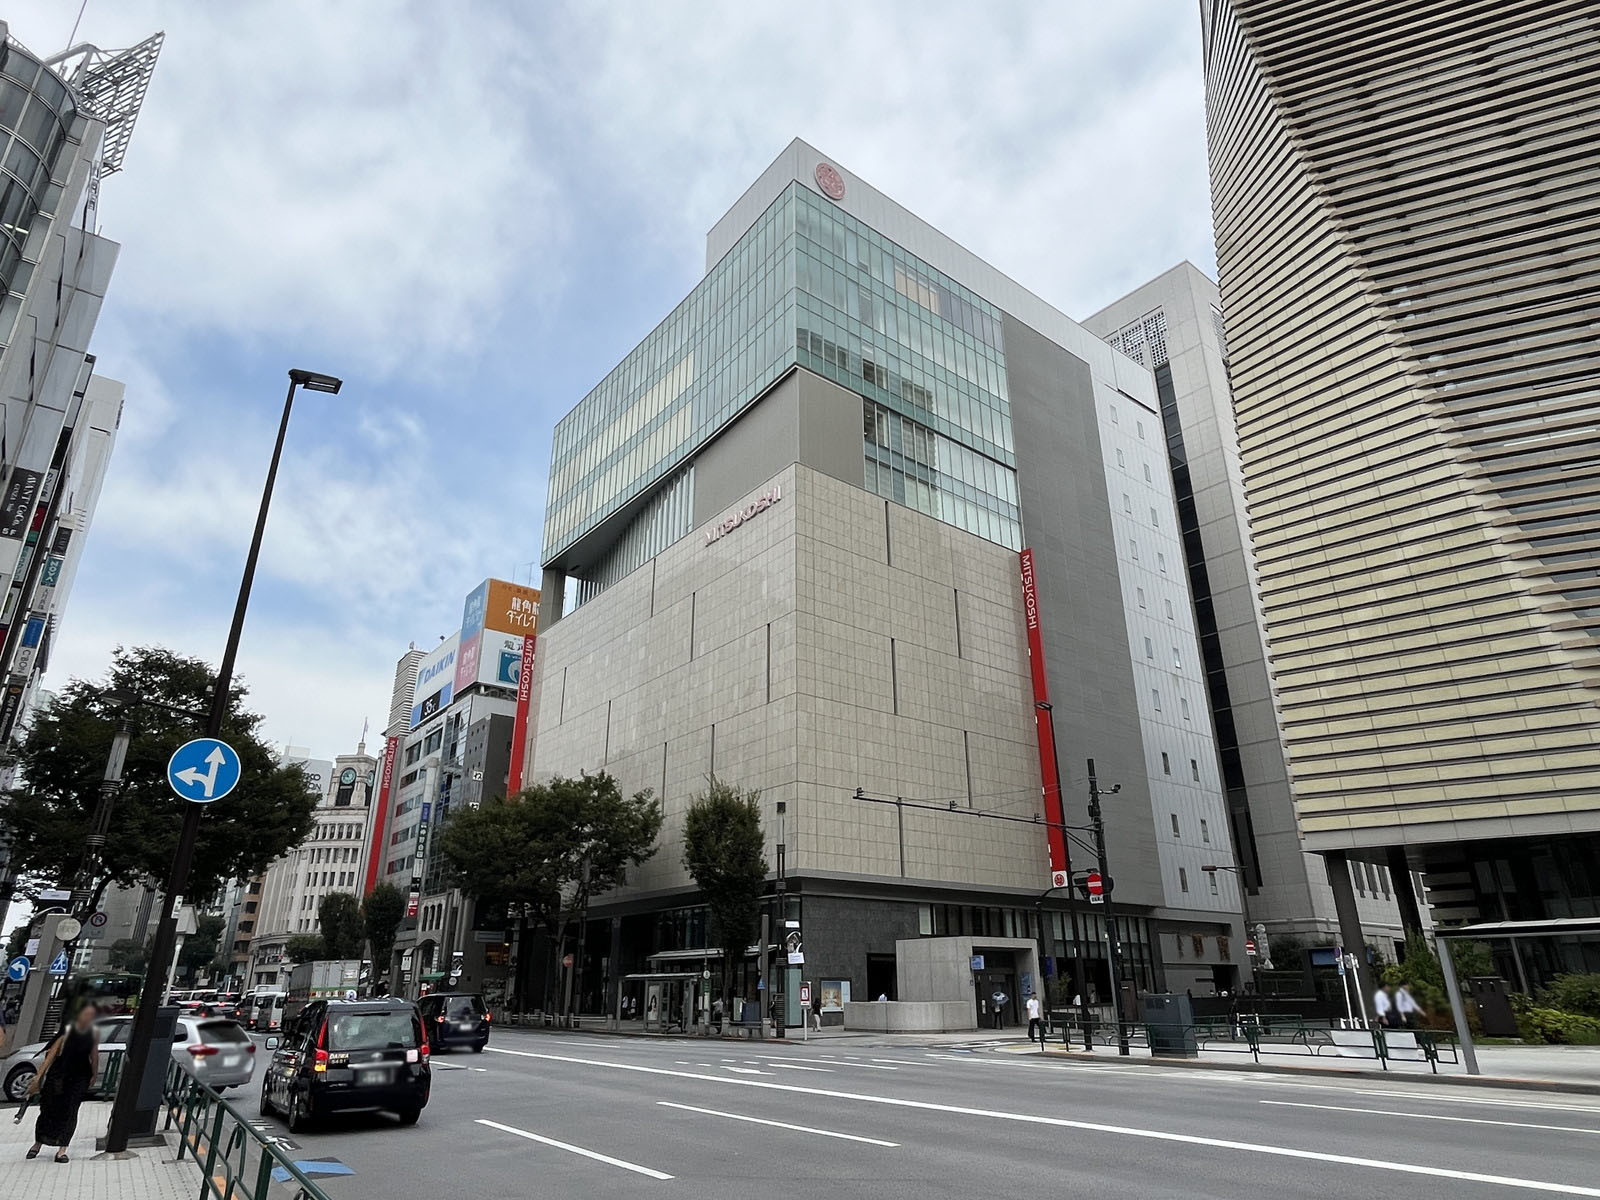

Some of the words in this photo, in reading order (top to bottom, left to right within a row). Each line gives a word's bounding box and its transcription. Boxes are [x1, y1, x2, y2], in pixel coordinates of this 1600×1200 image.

[704, 485, 782, 547] MITSUKOSHI
[46, 560, 59, 583] NOVA
[1022, 554, 1037, 630] MITSUKOSHI
[424, 649, 456, 684] DAIKIN
[521, 638, 534, 701] MITSUKOSHI
[383, 740, 396, 789] MITSUKOSHI
